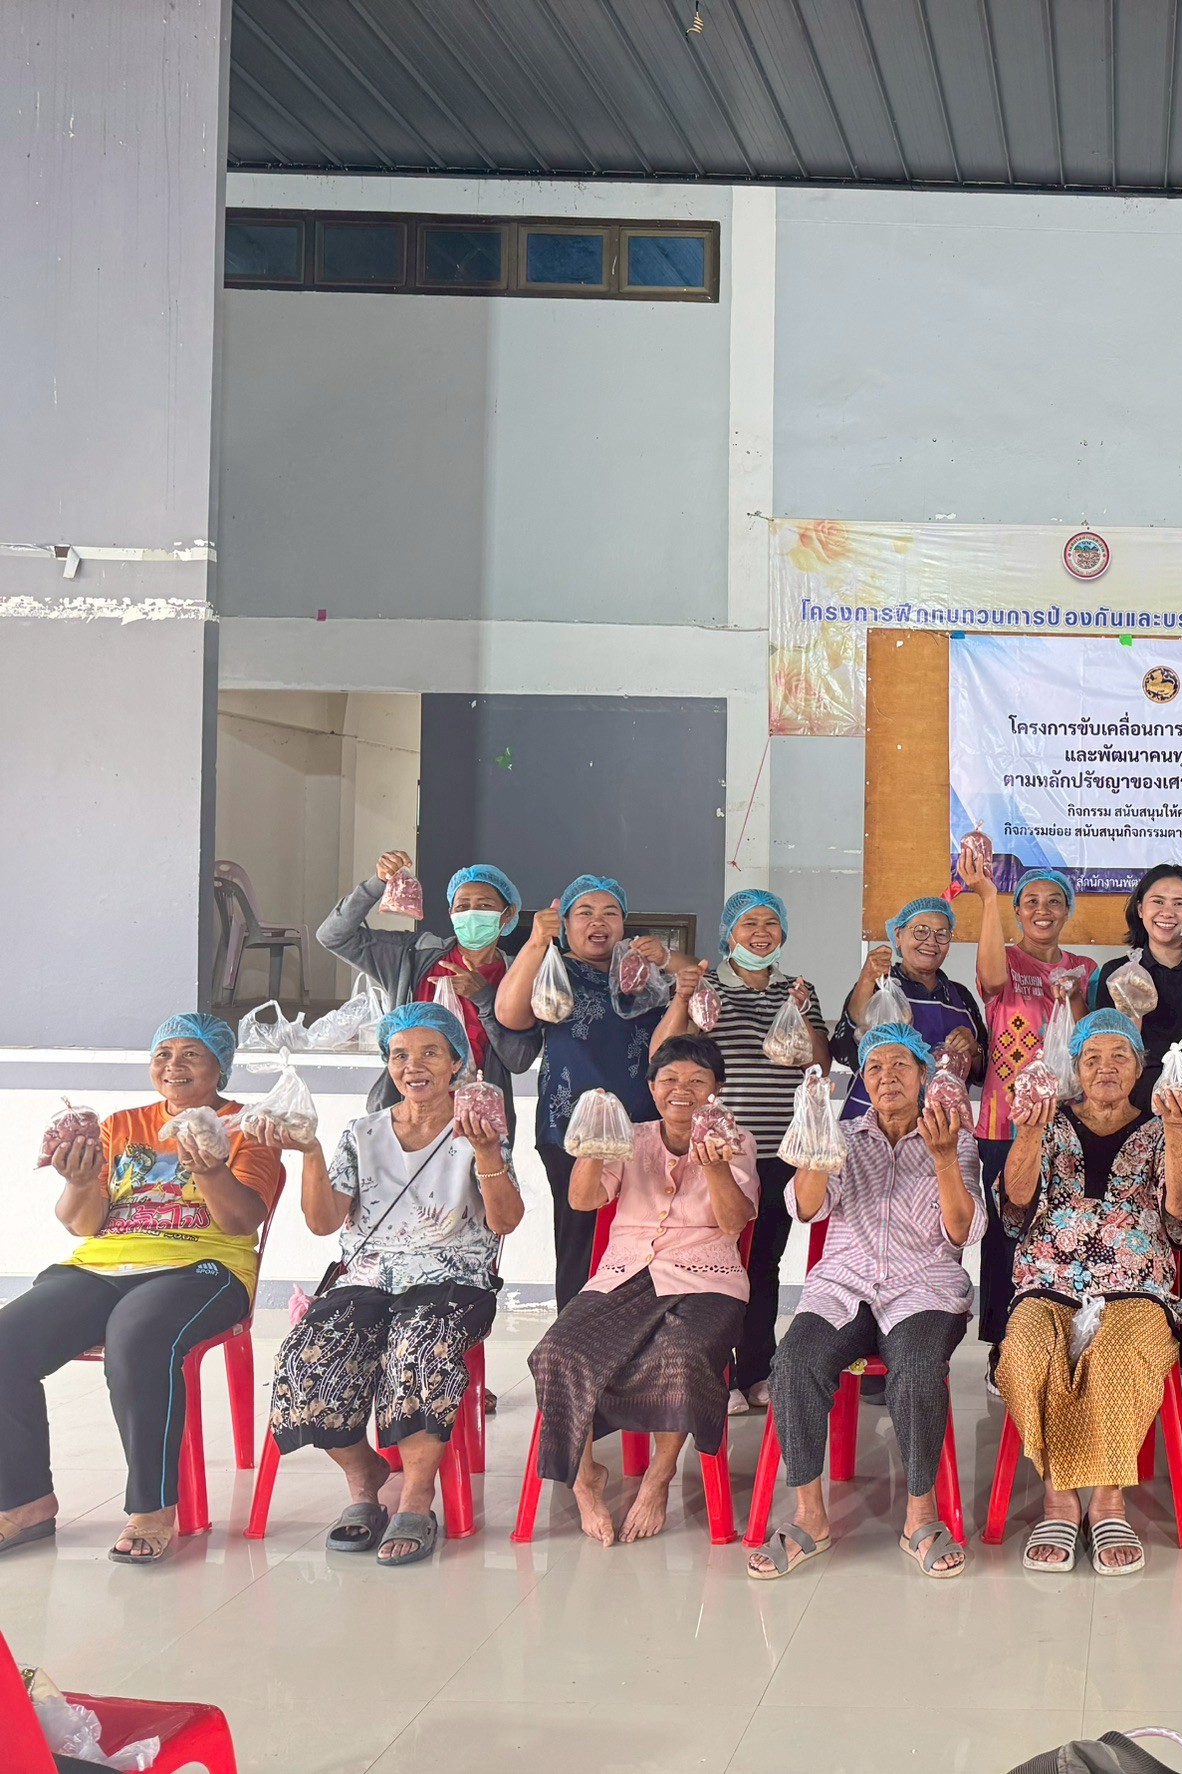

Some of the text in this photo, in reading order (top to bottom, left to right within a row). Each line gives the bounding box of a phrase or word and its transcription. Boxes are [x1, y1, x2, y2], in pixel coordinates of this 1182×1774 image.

[1067, 804, 1111, 818] กิจกรรม
[1004, 822, 1072, 837] กิจกรรมย่อย
